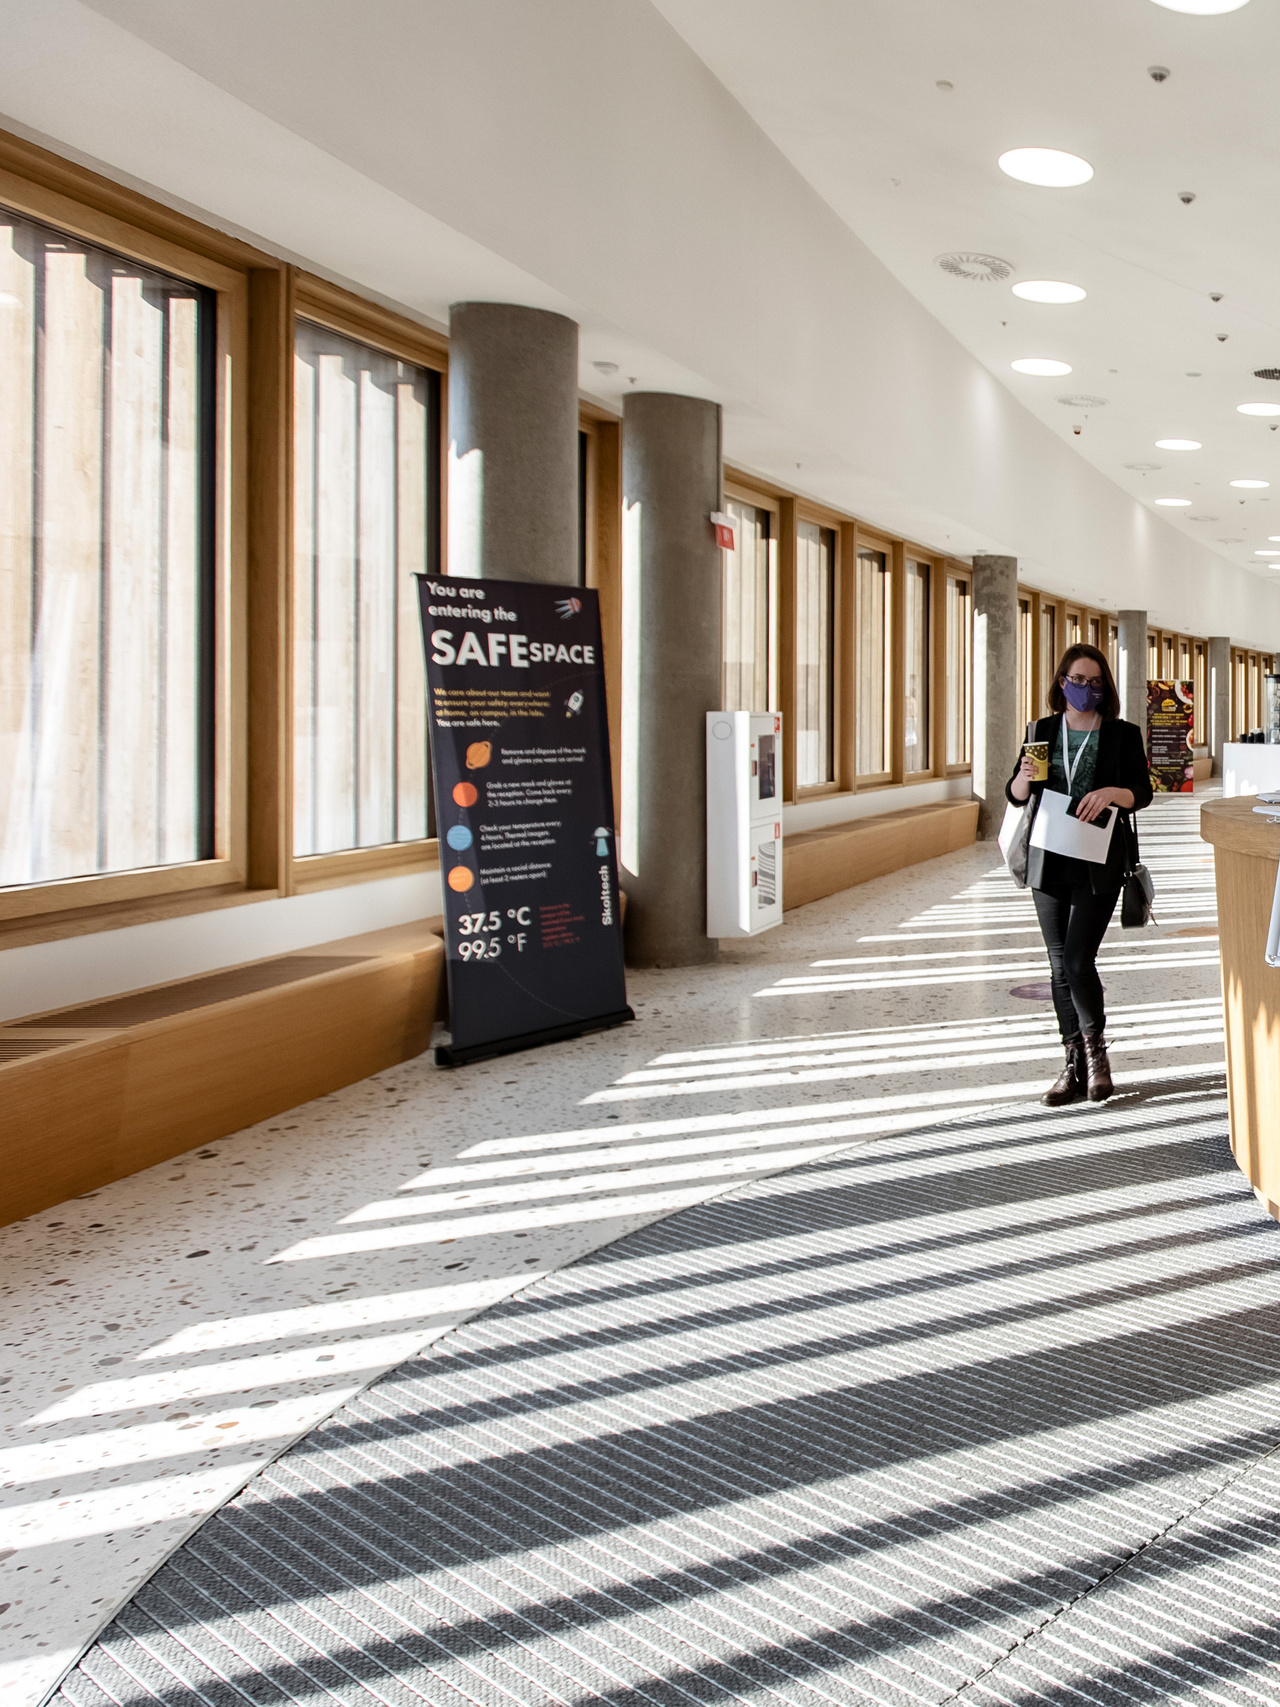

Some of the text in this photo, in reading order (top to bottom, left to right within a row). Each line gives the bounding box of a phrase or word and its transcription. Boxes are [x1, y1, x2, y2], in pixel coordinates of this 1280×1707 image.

[426, 582, 486, 599] You are
[428, 604, 517, 623] entering the
[434, 688, 447, 697] We
[466, 688, 487, 697] about
[519, 690, 532, 698] and
[434, 699, 442, 707] to
[470, 700, 486, 708] your
[488, 699, 508, 708] safety
[436, 719, 451, 727] You
[466, 719, 481, 727] safe
[482, 719, 501, 727] here.
[598, 865, 613, 926] Skoltech
[458, 910, 502, 936] 37.5
[507, 906, 532, 926] °C
[458, 933, 527, 962] 99.5 °F
